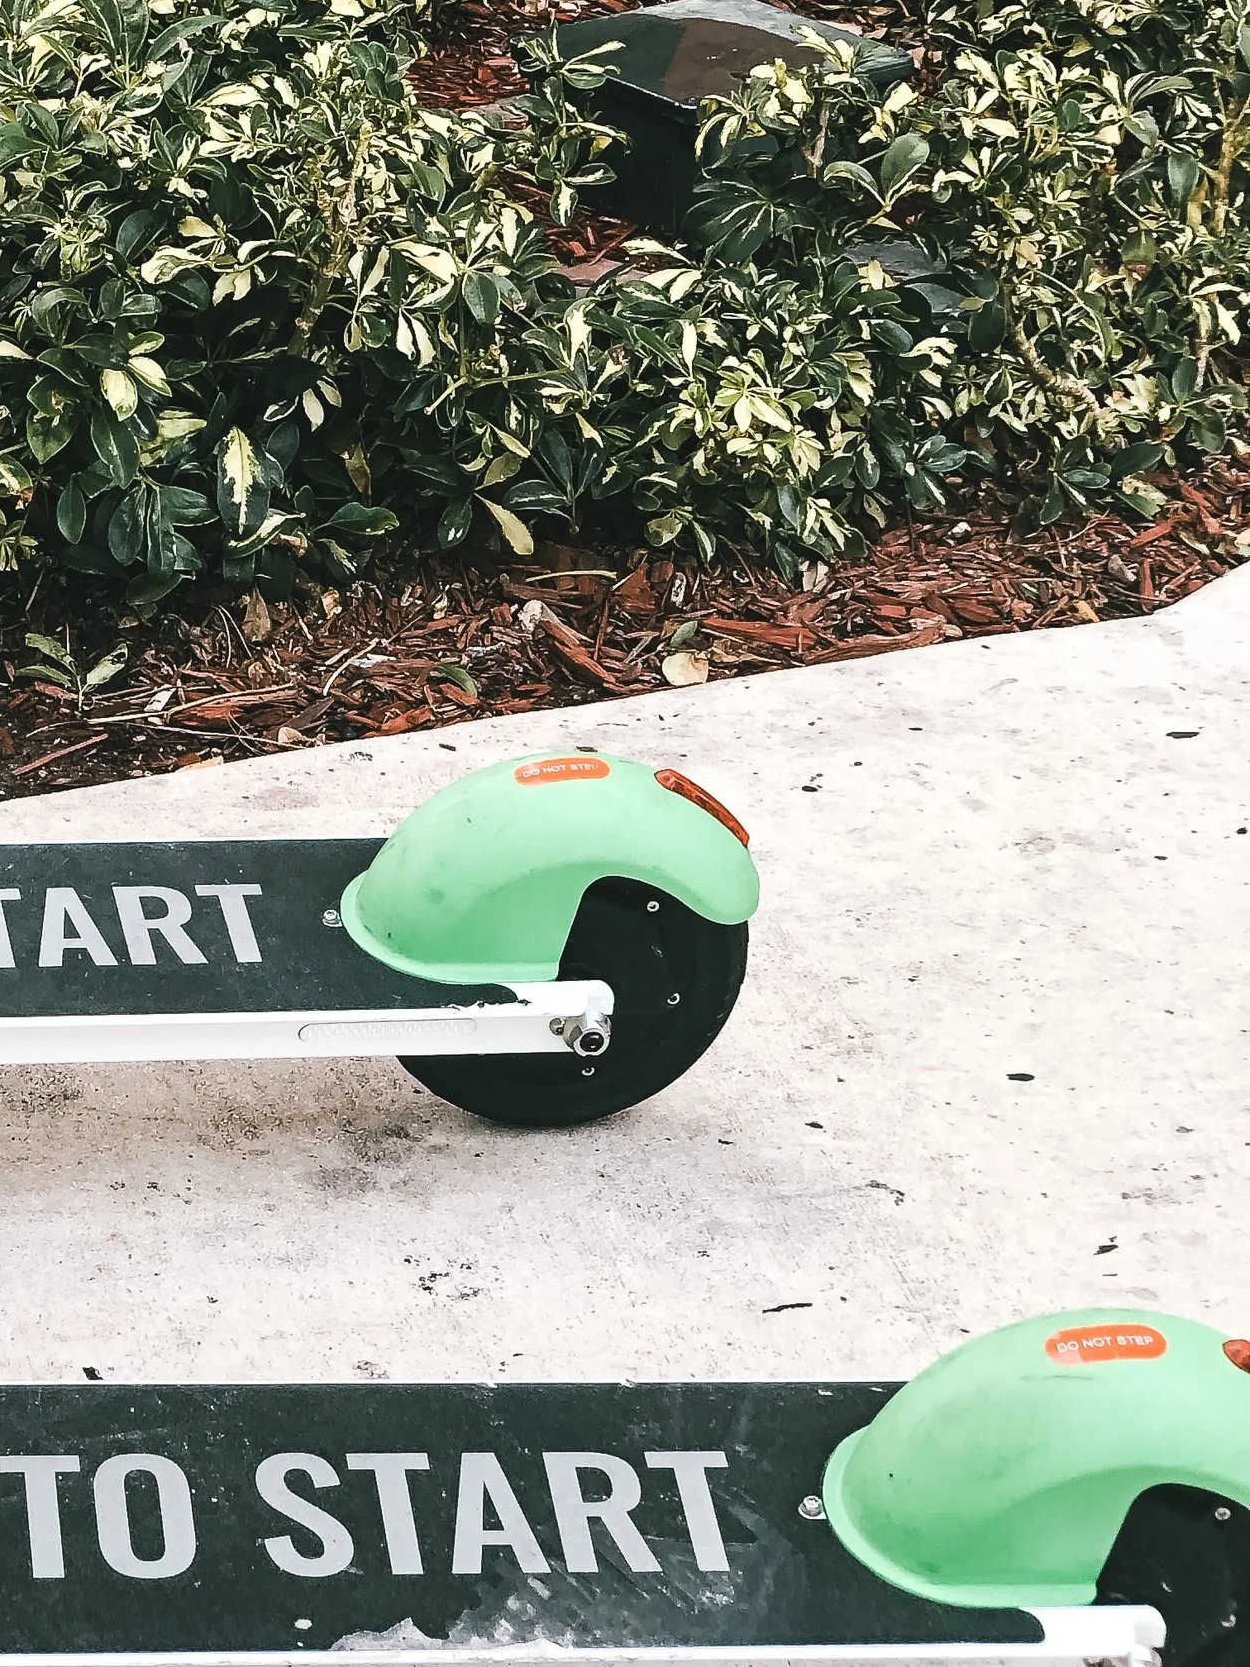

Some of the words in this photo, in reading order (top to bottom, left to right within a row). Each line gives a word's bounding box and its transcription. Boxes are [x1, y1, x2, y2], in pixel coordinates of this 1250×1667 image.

[522, 767, 541, 778] DO
[542, 764, 566, 774] NOT
[1056, 1341, 1080, 1353] DO
[1081, 1337, 1112, 1348] NOT
[1116, 1335, 1154, 1346] STEP
[253, 1451, 730, 1578] START
